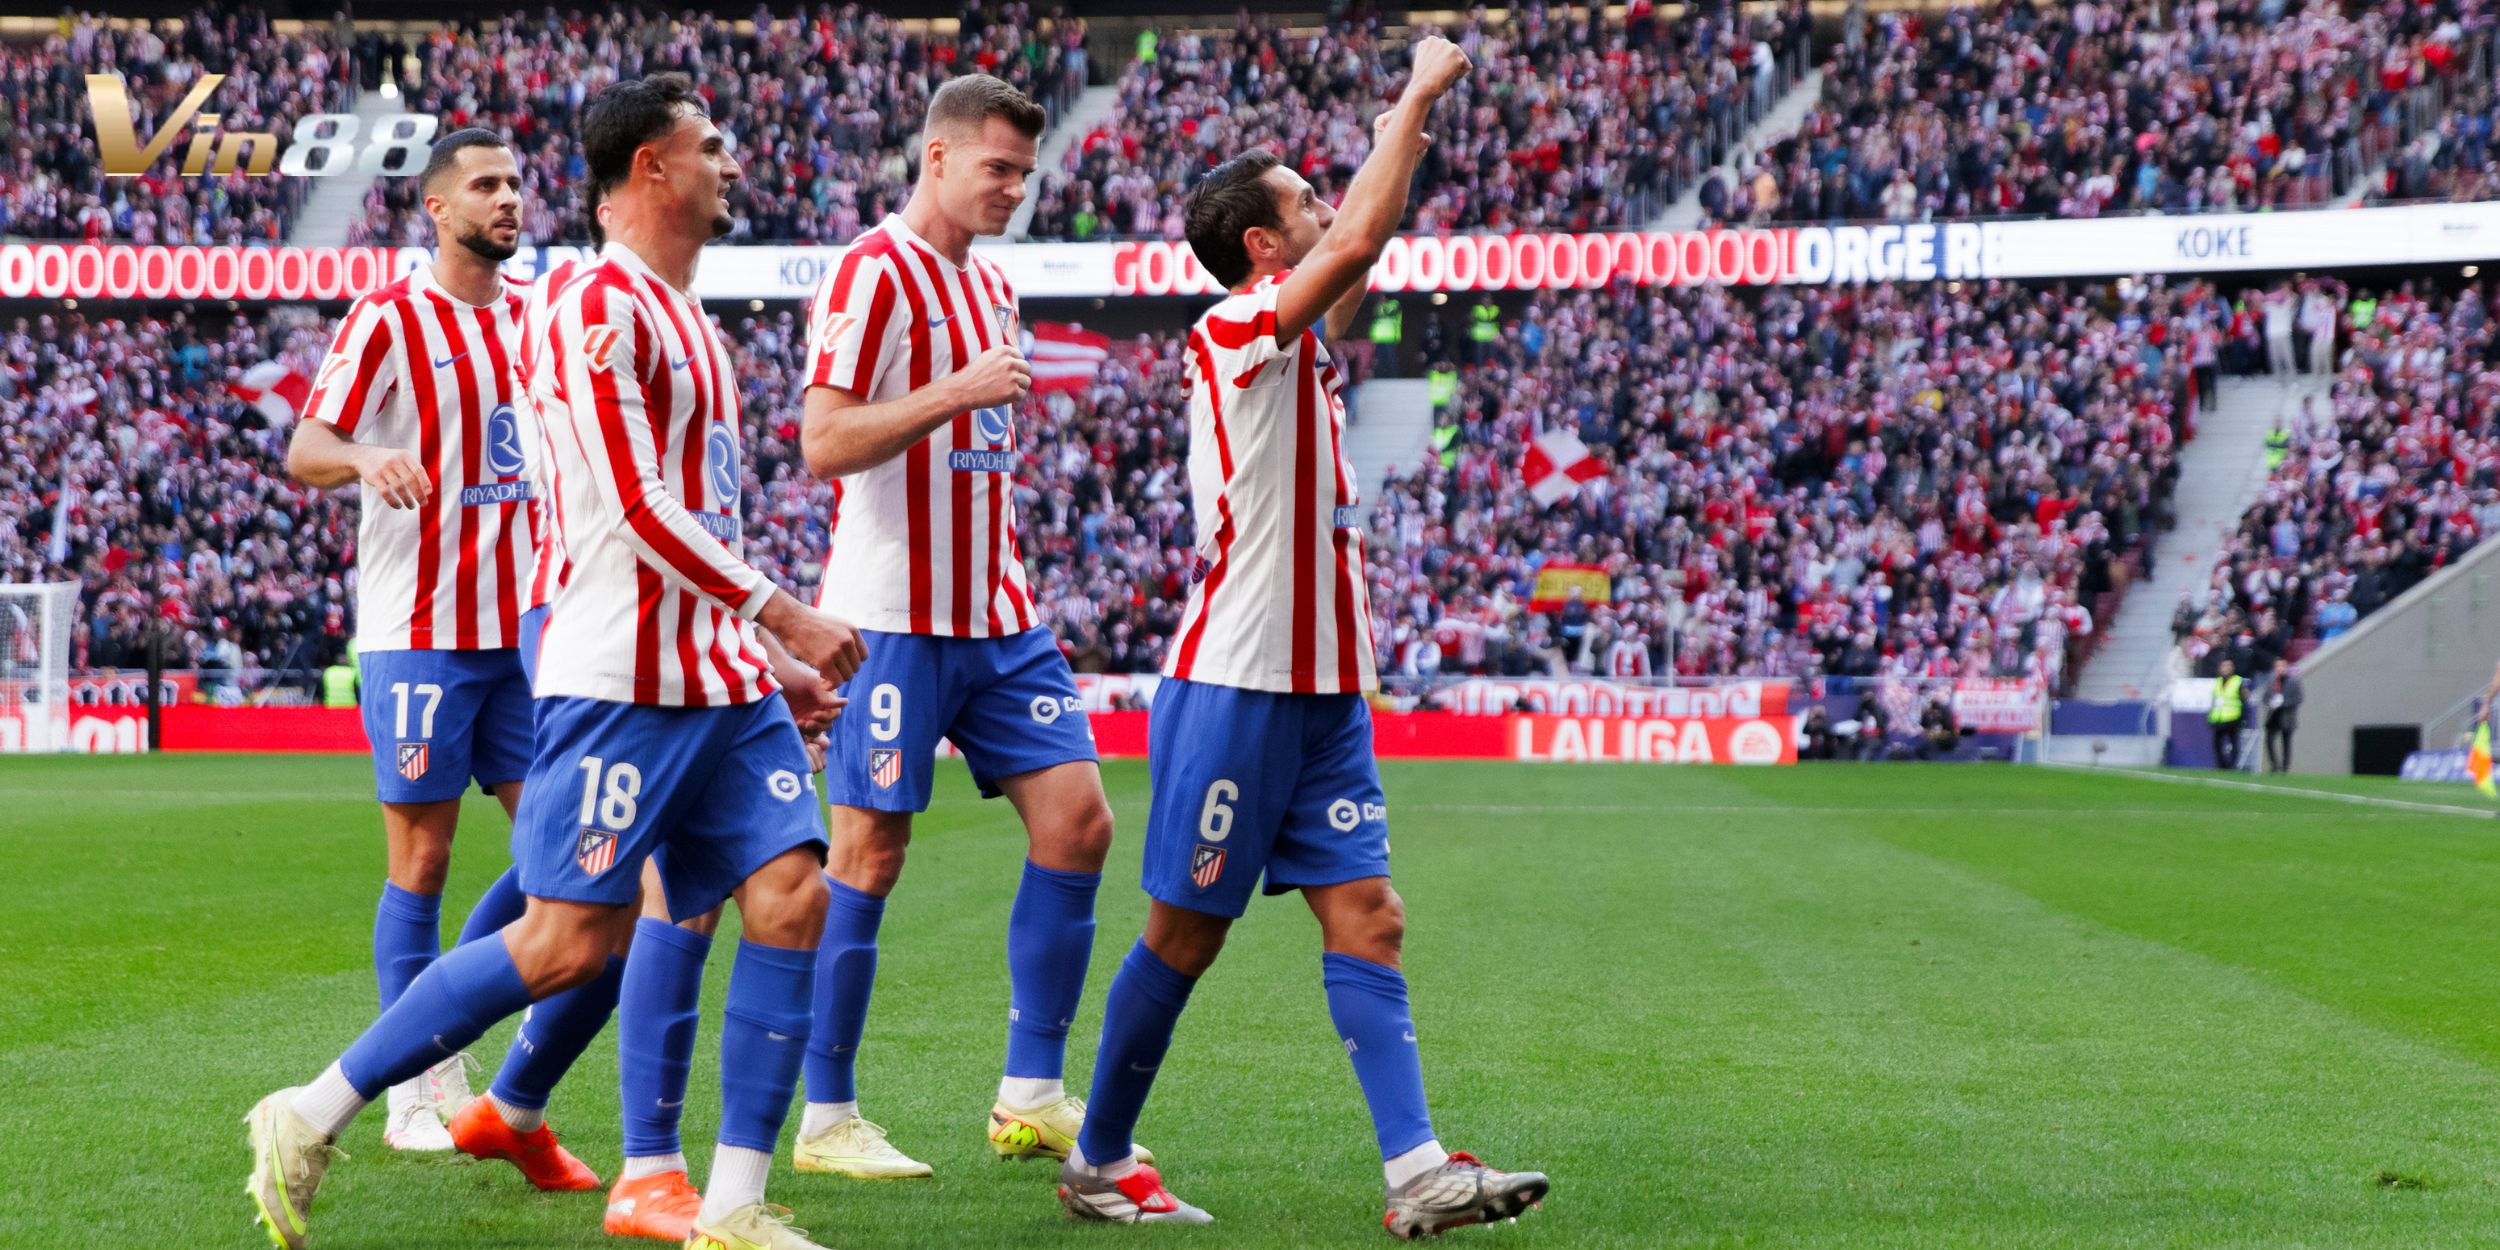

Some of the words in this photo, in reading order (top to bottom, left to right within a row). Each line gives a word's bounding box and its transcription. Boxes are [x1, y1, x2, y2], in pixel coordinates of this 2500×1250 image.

[2177, 227, 2253, 257] KOKE
[954, 451, 1004, 470] RIYADH
[464, 482, 526, 503] RIYADH
[391, 682, 443, 738] 17
[871, 683, 901, 741] 9
[1515, 718, 1714, 763] LALIGA
[580, 756, 641, 829] 18
[1201, 779, 1239, 842] 6
